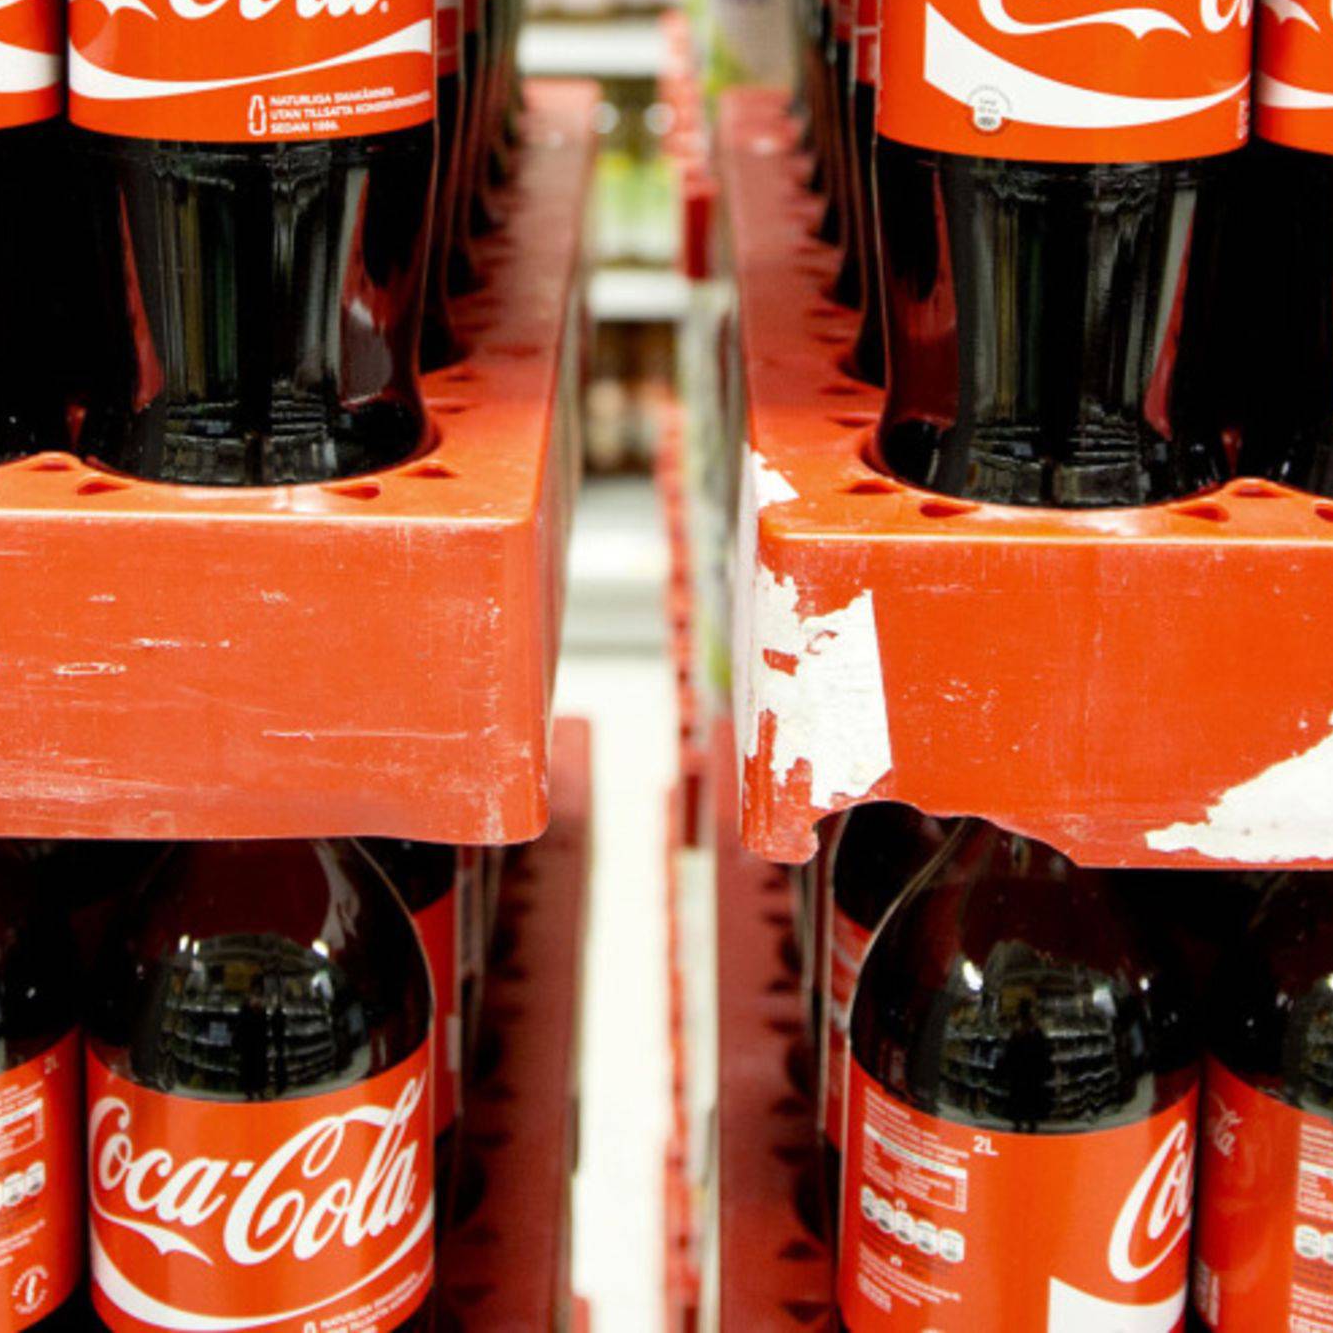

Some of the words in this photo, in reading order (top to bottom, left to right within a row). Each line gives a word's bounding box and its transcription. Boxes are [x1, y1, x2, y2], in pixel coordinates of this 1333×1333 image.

[270, 122, 310, 134] SEDAN
[973, 1136, 999, 1156] 2L
[89, 1070, 427, 1265] Coca-Cola
